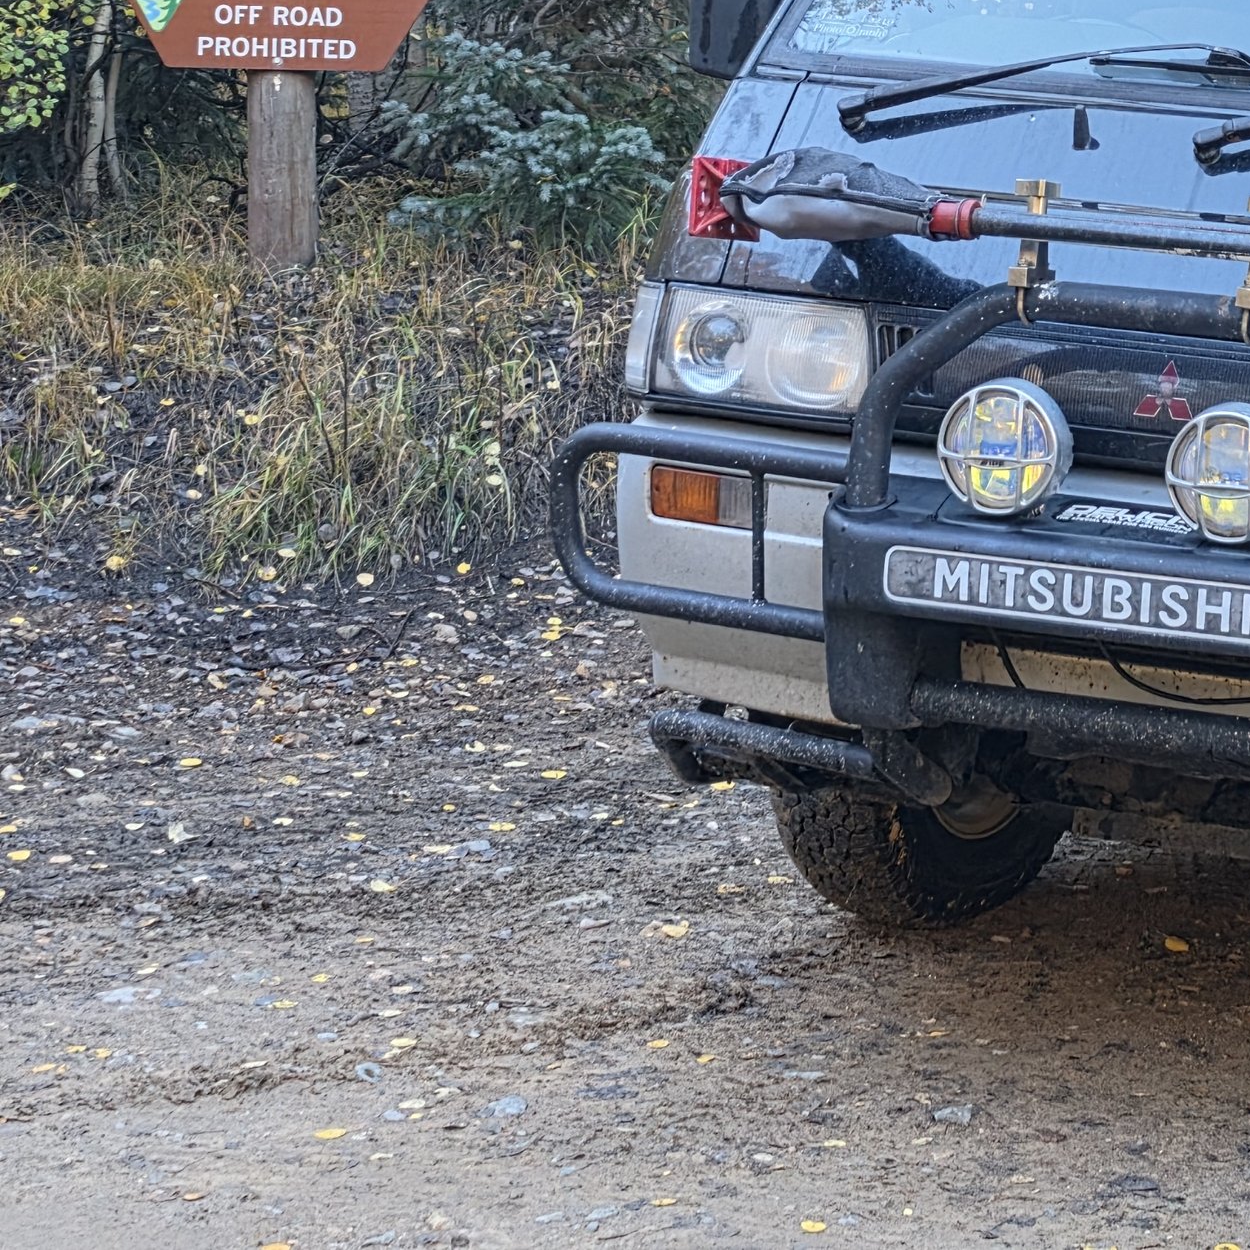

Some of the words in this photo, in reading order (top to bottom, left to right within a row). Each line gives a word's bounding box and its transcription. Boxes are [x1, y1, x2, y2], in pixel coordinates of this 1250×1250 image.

[214, 3, 264, 25] OFF
[272, 5, 344, 27] ROAD
[197, 36, 357, 59] PROHIBITED
